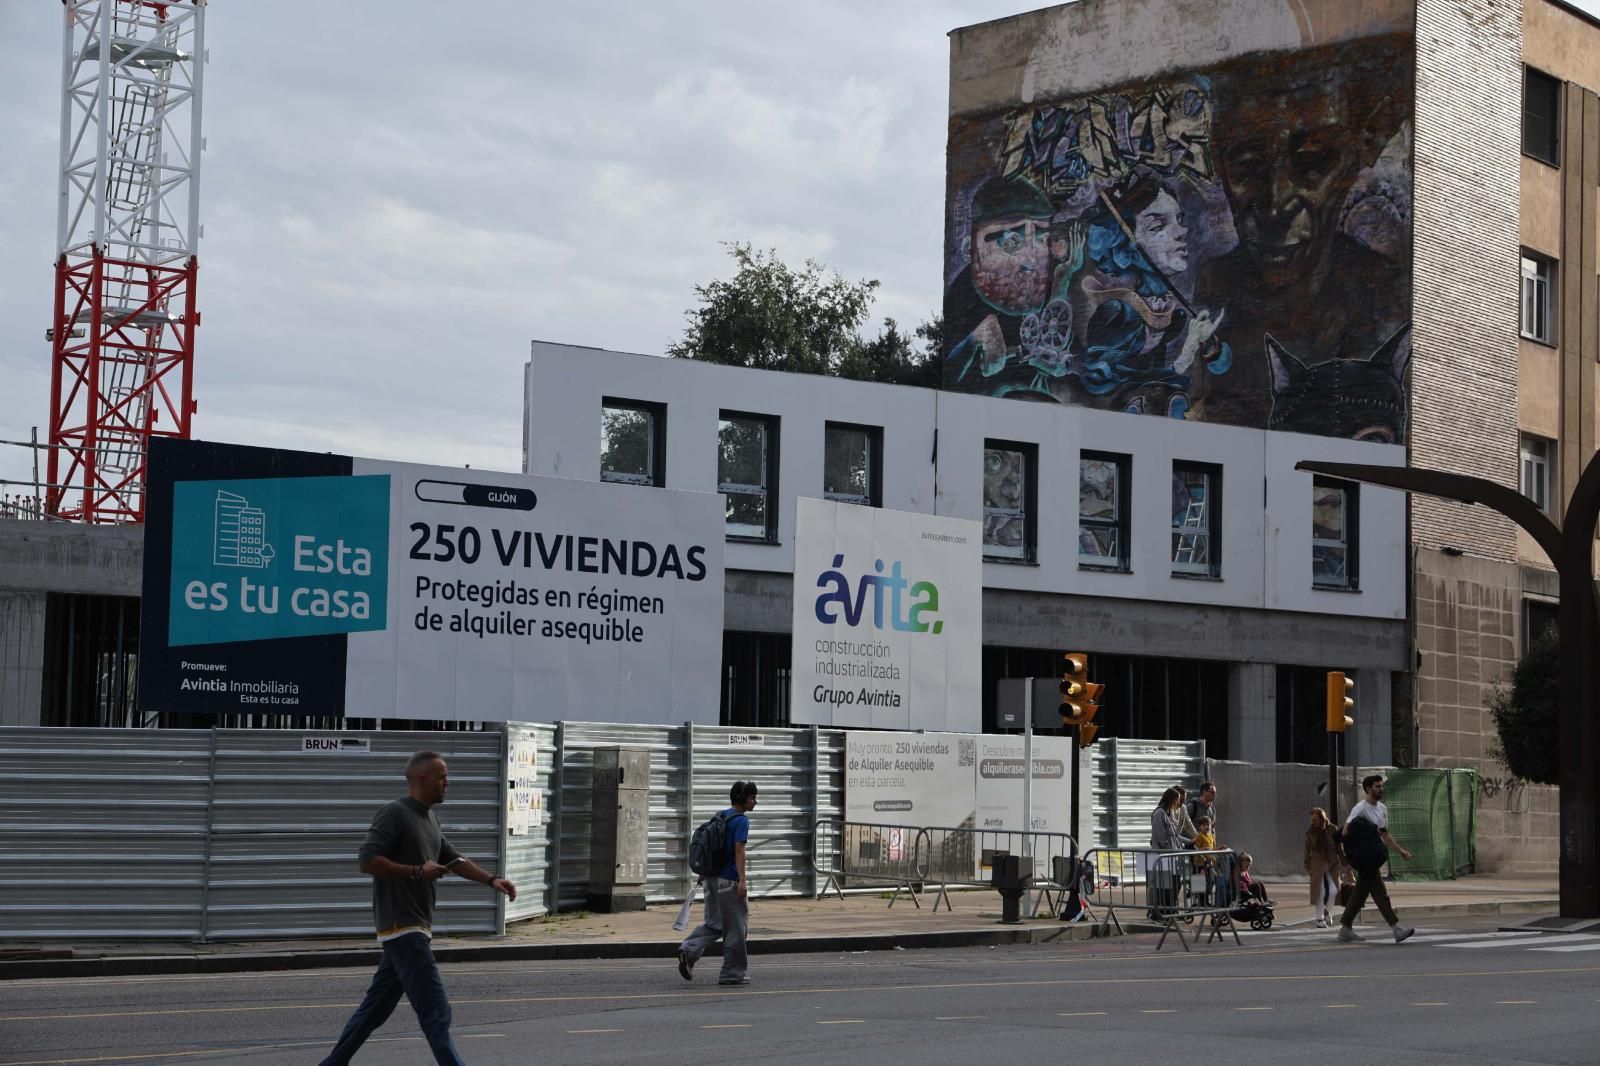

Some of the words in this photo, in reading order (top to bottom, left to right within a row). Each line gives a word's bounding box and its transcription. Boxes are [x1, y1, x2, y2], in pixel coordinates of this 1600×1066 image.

[488, 491, 517, 504] GIJÓN
[293, 535, 372, 576] Esta
[409, 521, 481, 565] 250
[491, 528, 707, 581] VIVIENDAS
[184, 579, 228, 612] es
[240, 576, 279, 614] tu
[291, 586, 370, 620] casa
[415, 575, 539, 608] Protegidas
[544, 588, 571, 608] en
[577, 586, 664, 616] régimen
[414, 606, 442, 631] de
[449, 608, 536, 639] alquiler
[541, 617, 644, 645] asequible
[815, 639, 890, 658] construcción
[180, 661, 227, 672] Promueve:
[815, 656, 900, 680] industrializada
[180, 678, 227, 692] Avintia
[230, 680, 299, 694] Inmobiliaria
[240, 694, 258, 704] Esta
[259, 696, 269, 704] es
[270, 696, 280, 704] tu
[282, 696, 299, 705] casa
[813, 684, 854, 709] Grupo
[856, 688, 901, 708] Avintia
[305, 738, 338, 750] BRUN
[896, 742, 910, 754] 250
[912, 742, 949, 754] viviendas
[848, 758, 859, 771] de
[861, 758, 892, 773] Alquiler
[894, 759, 934, 773] Asequible
[983, 762, 1061, 776] alquileraseible.com
